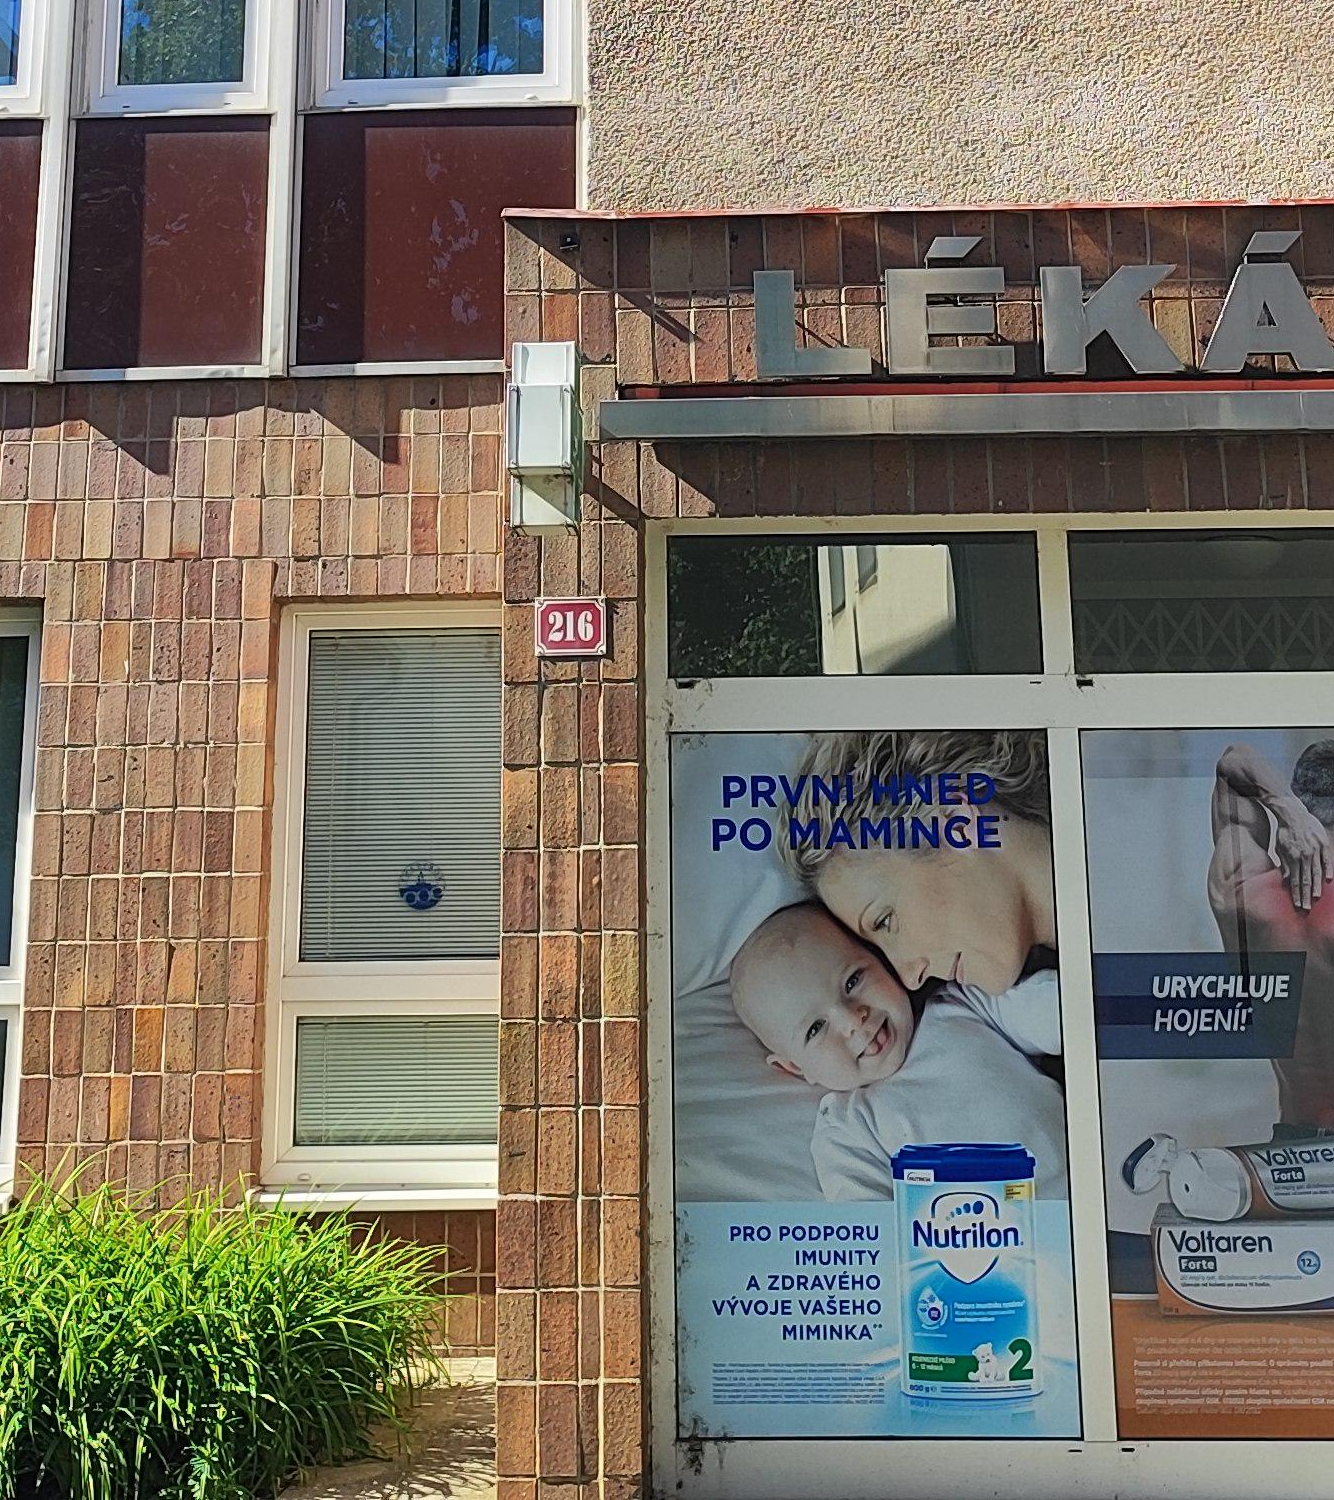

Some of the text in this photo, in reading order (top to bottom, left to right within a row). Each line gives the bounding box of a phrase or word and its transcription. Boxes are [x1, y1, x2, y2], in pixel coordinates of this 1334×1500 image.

[547, 610, 594, 642] 216
[722, 765, 997, 808] PRVNÍ HNED
[712, 816, 772, 852] PO
[1151, 974, 1290, 1002] URYCHLUJE
[1273, 1169, 1304, 1182] Forte
[729, 1225, 880, 1242] PRO PODPORU
[912, 1219, 1019, 1249] Nutrilon
[1167, 1230, 1273, 1254] Voltaren
[795, 1249, 881, 1267] IMUNITY
[1180, 1258, 1216, 1272] Forte
[745, 1270, 882, 1292] A ZDRAVÉHO
[712, 1295, 883, 1317] VÝVOJE VAŠEHO
[1008, 1338, 1034, 1381] 2
